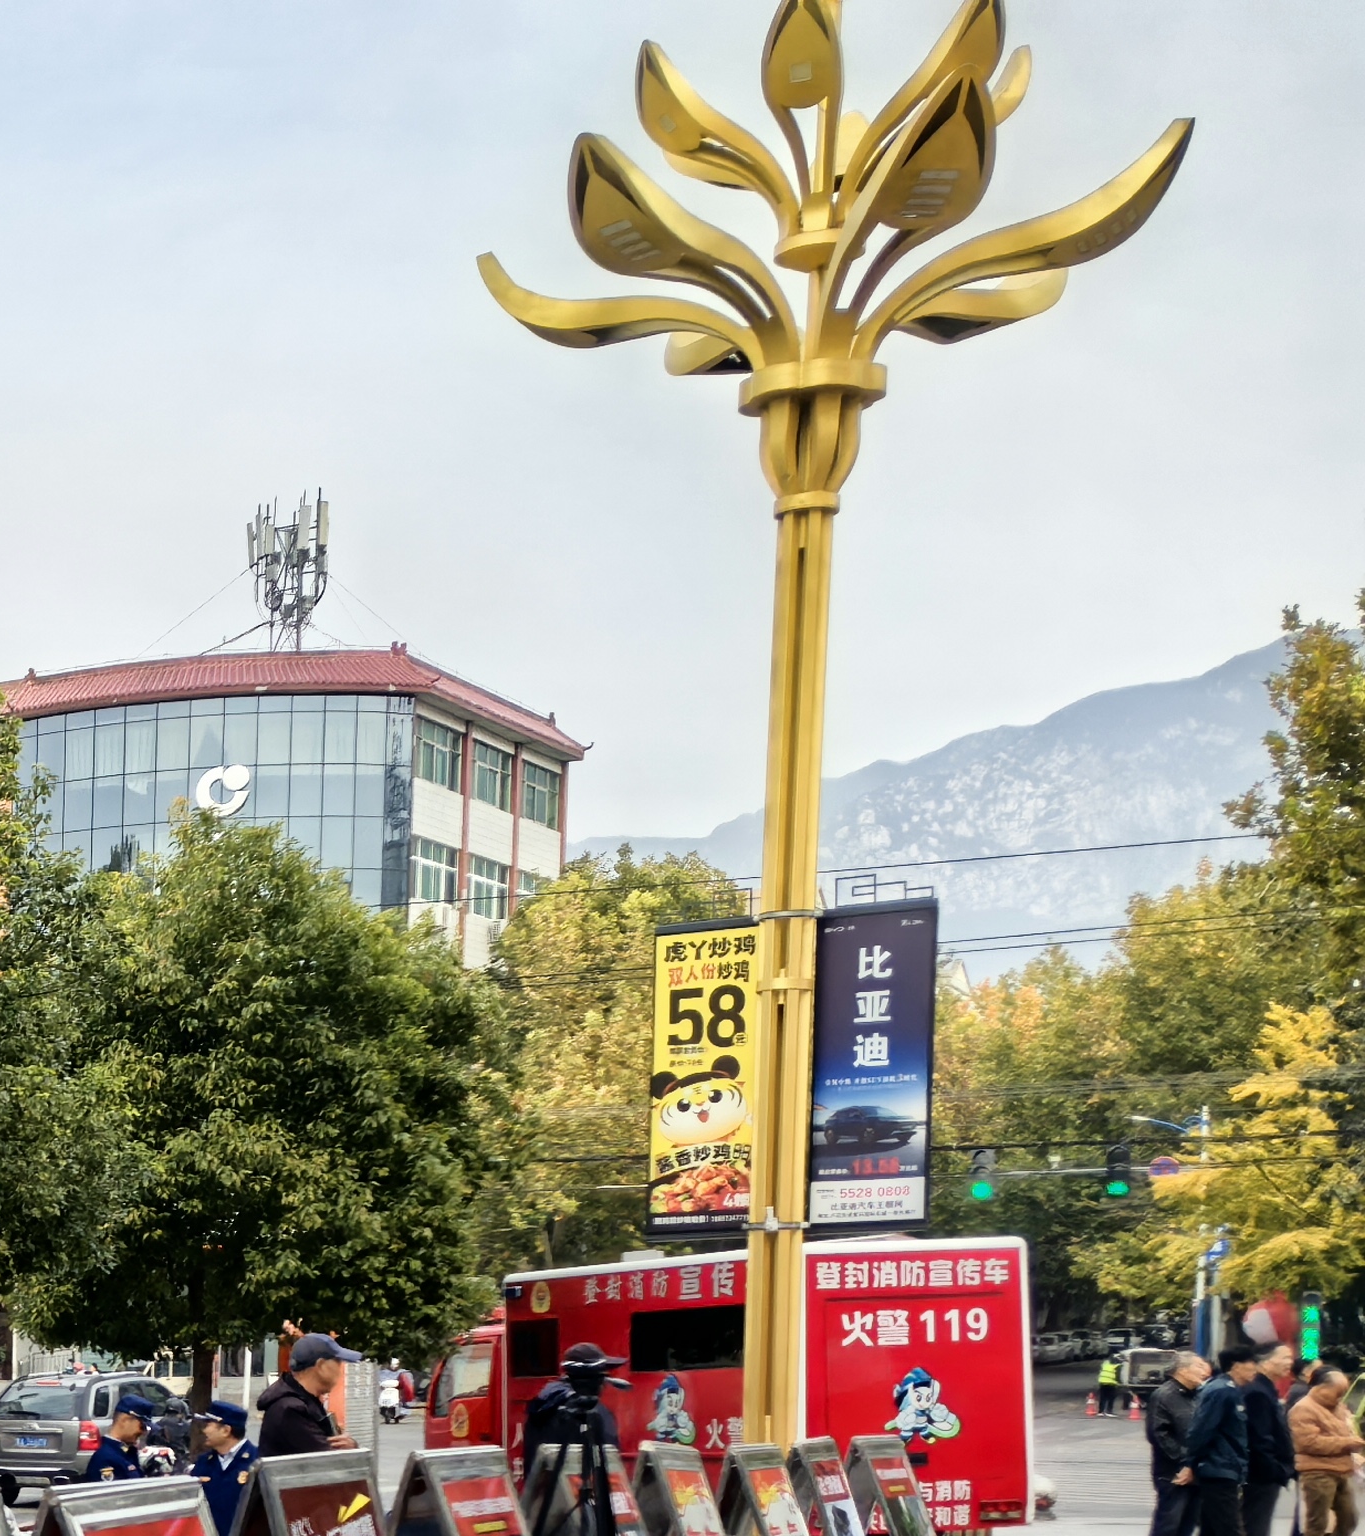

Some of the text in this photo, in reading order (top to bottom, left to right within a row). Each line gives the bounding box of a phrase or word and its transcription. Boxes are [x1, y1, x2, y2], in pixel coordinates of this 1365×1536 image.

[664, 935, 755, 962] 虎丫炒鸡
[668, 960, 749, 987] 双人份炒鸡
[667, 984, 746, 1048] 58
[853, 945, 892, 1068] 比亚迪
[816, 1258, 1009, 1290] 登封消防宣传车
[841, 1307, 988, 1346] 火警 119
